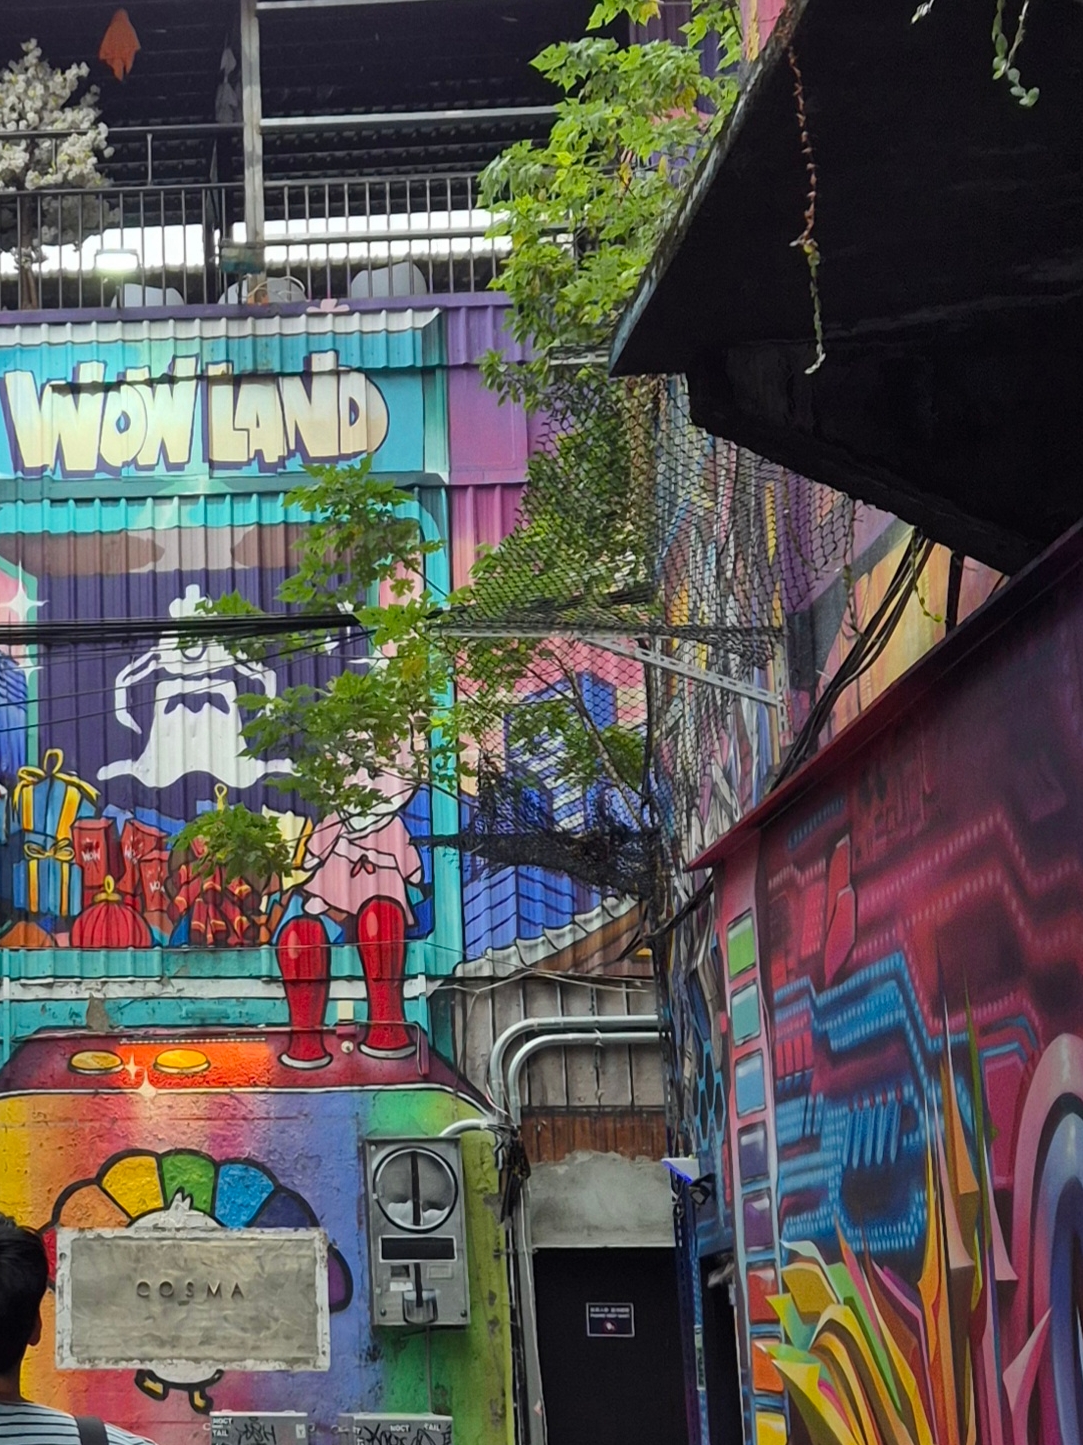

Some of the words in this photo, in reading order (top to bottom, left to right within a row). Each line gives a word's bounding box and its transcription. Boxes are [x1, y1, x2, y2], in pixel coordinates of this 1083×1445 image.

[0, 353, 200, 474] WOW
[205, 350, 388, 465] LAND
[136, 1281, 244, 1299] COSMA
